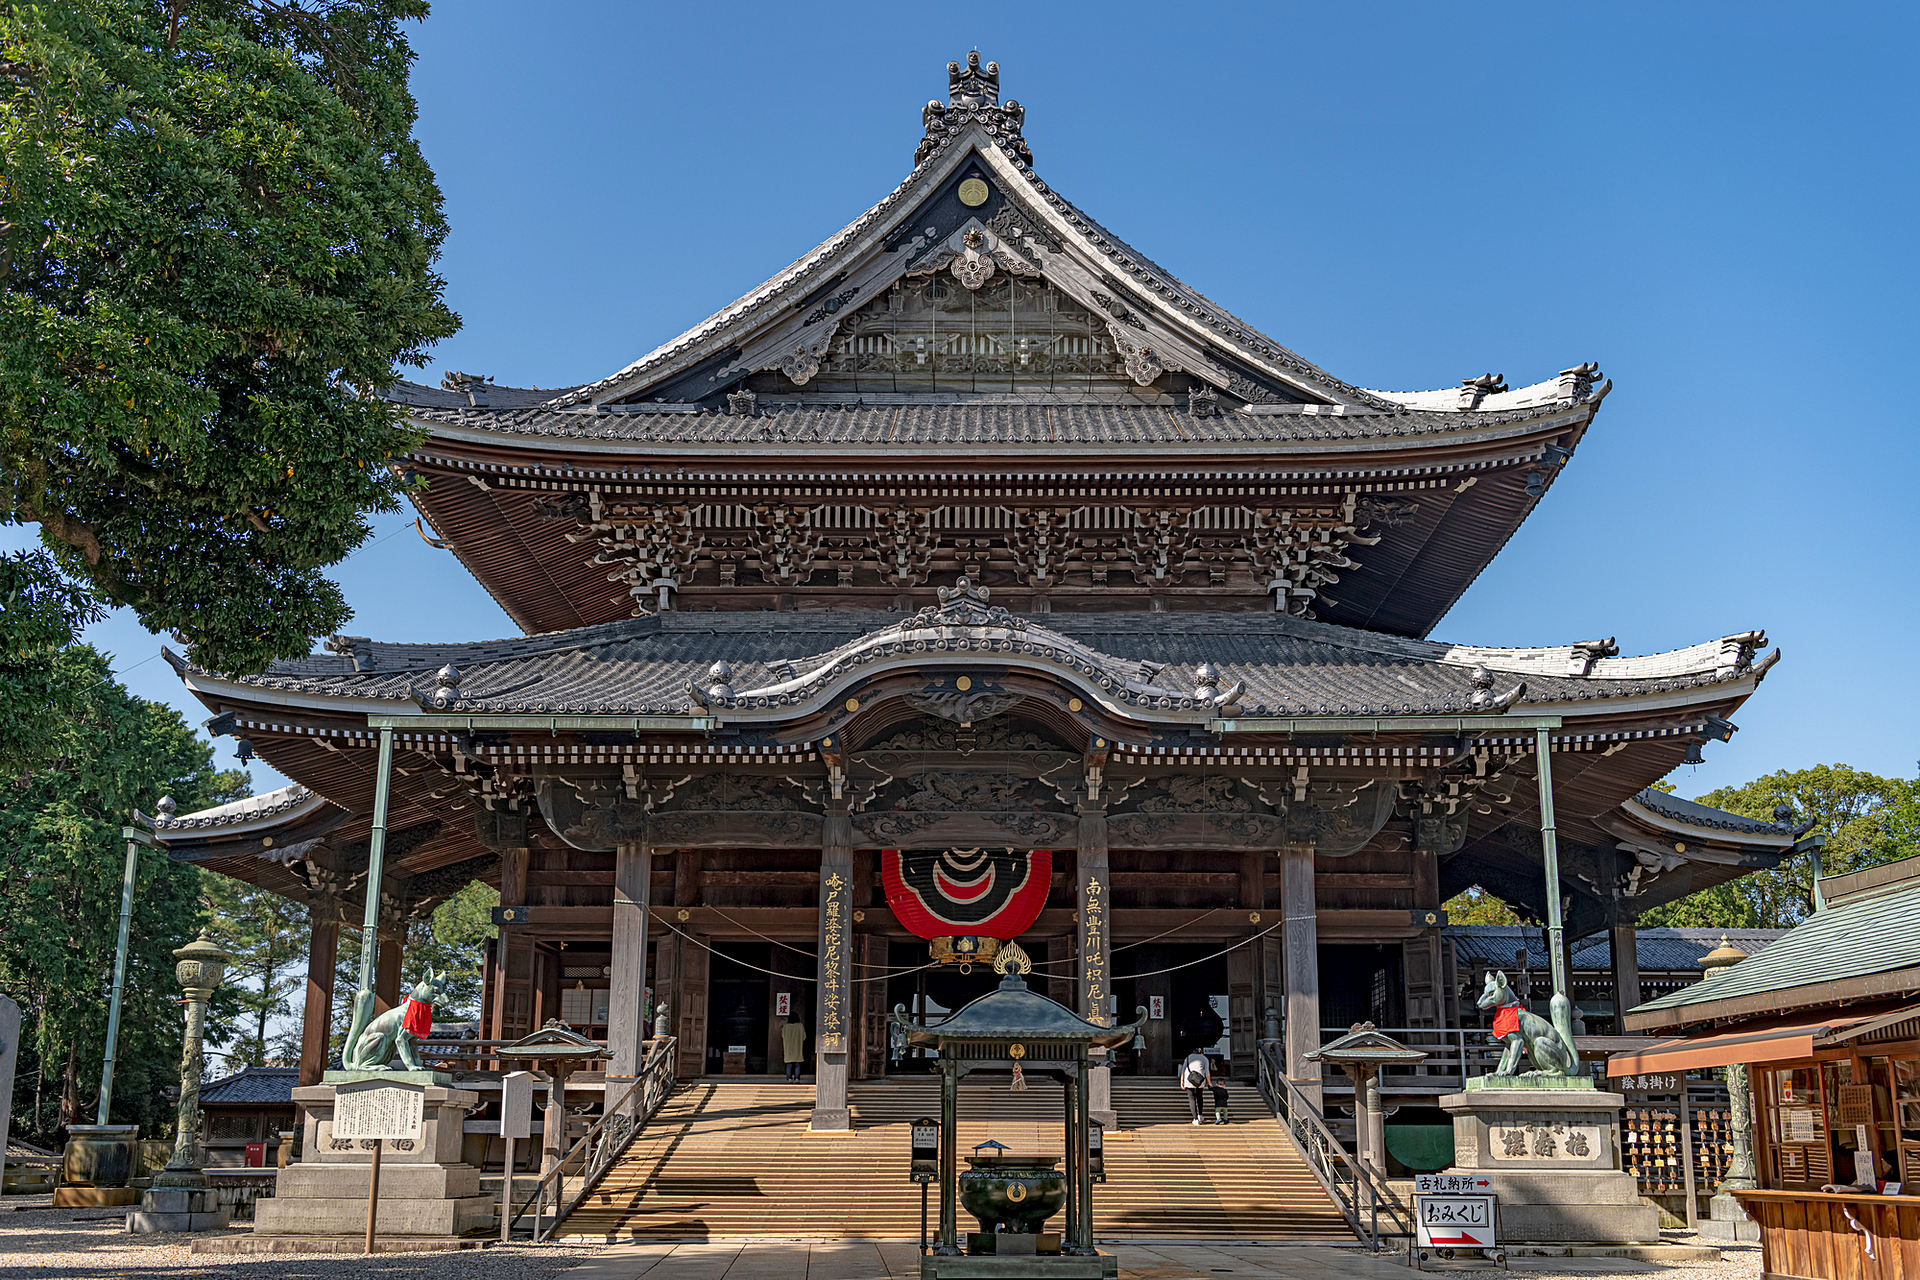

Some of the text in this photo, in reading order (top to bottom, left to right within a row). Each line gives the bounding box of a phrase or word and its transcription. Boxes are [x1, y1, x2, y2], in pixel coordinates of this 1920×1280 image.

[779, 995, 788, 1014] 禁煙
[1152, 998, 1162, 1017] 禁煙
[1621, 1075, 1677, 1090] 絵馬掛け
[1419, 1176, 1475, 1191] 古札納所
[1427, 1203, 1484, 1223] おみくじ
